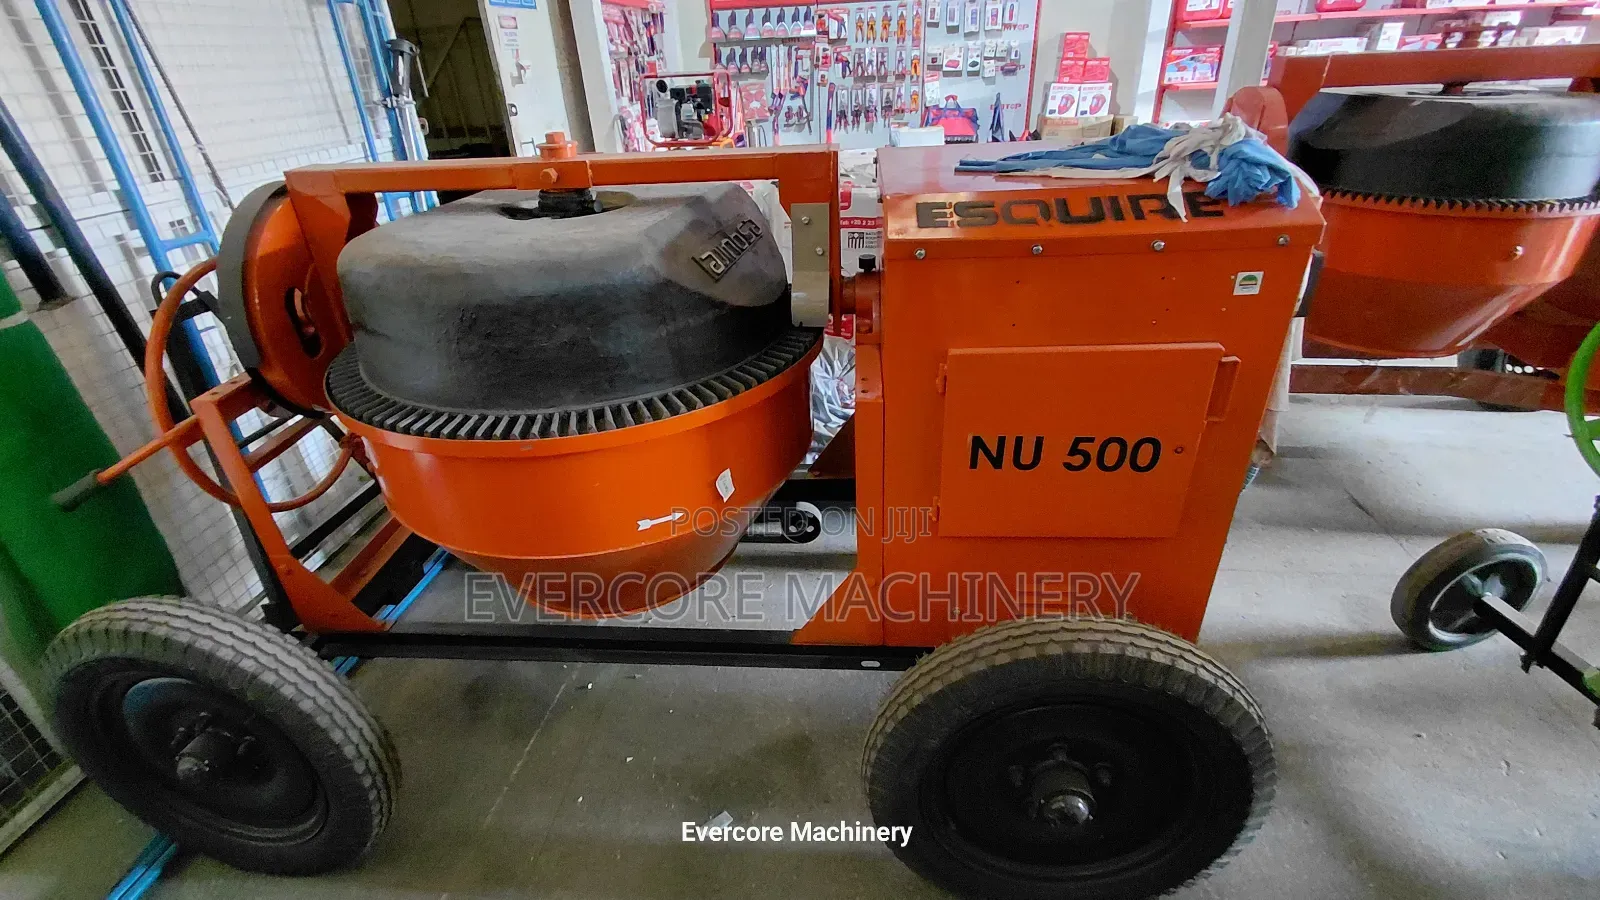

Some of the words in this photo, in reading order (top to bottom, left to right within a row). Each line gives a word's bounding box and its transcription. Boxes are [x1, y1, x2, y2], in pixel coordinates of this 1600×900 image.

[916, 191, 1224, 229] ESQUIRE
[968, 435, 1045, 471] NU
[1062, 436, 1162, 473] 500
